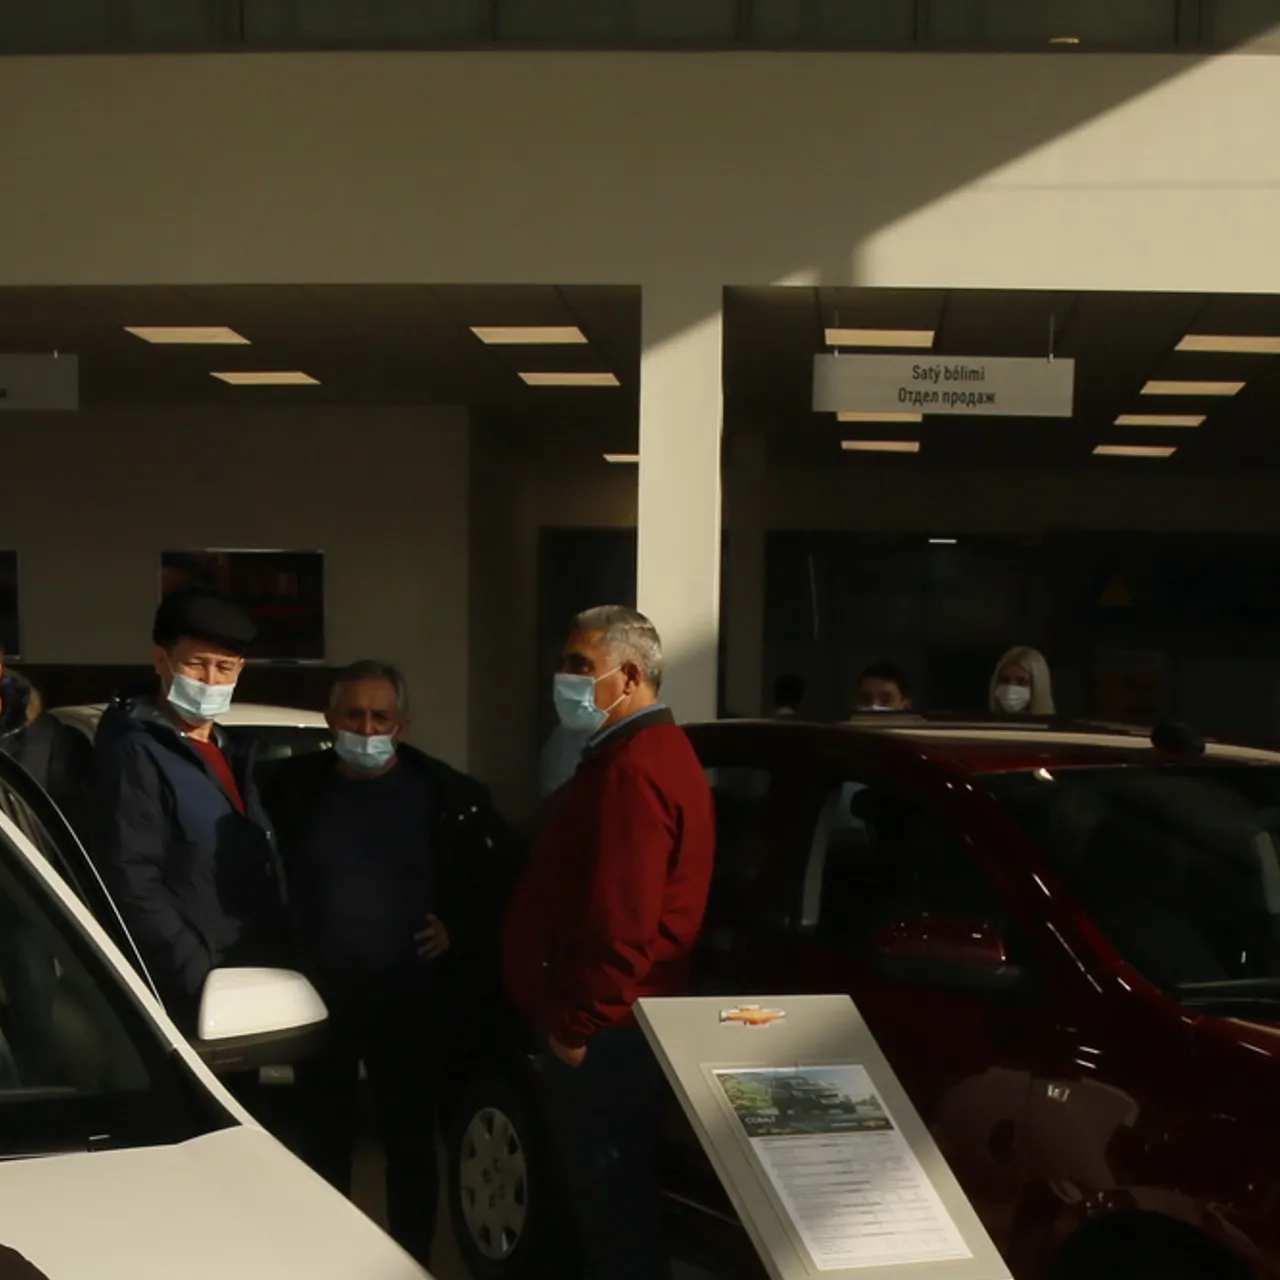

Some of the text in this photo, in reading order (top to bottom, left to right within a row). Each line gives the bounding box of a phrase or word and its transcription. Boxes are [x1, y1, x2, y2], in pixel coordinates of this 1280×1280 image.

[912, 365, 942, 383] Satý
[898, 387, 996, 407] Отдел продаж
